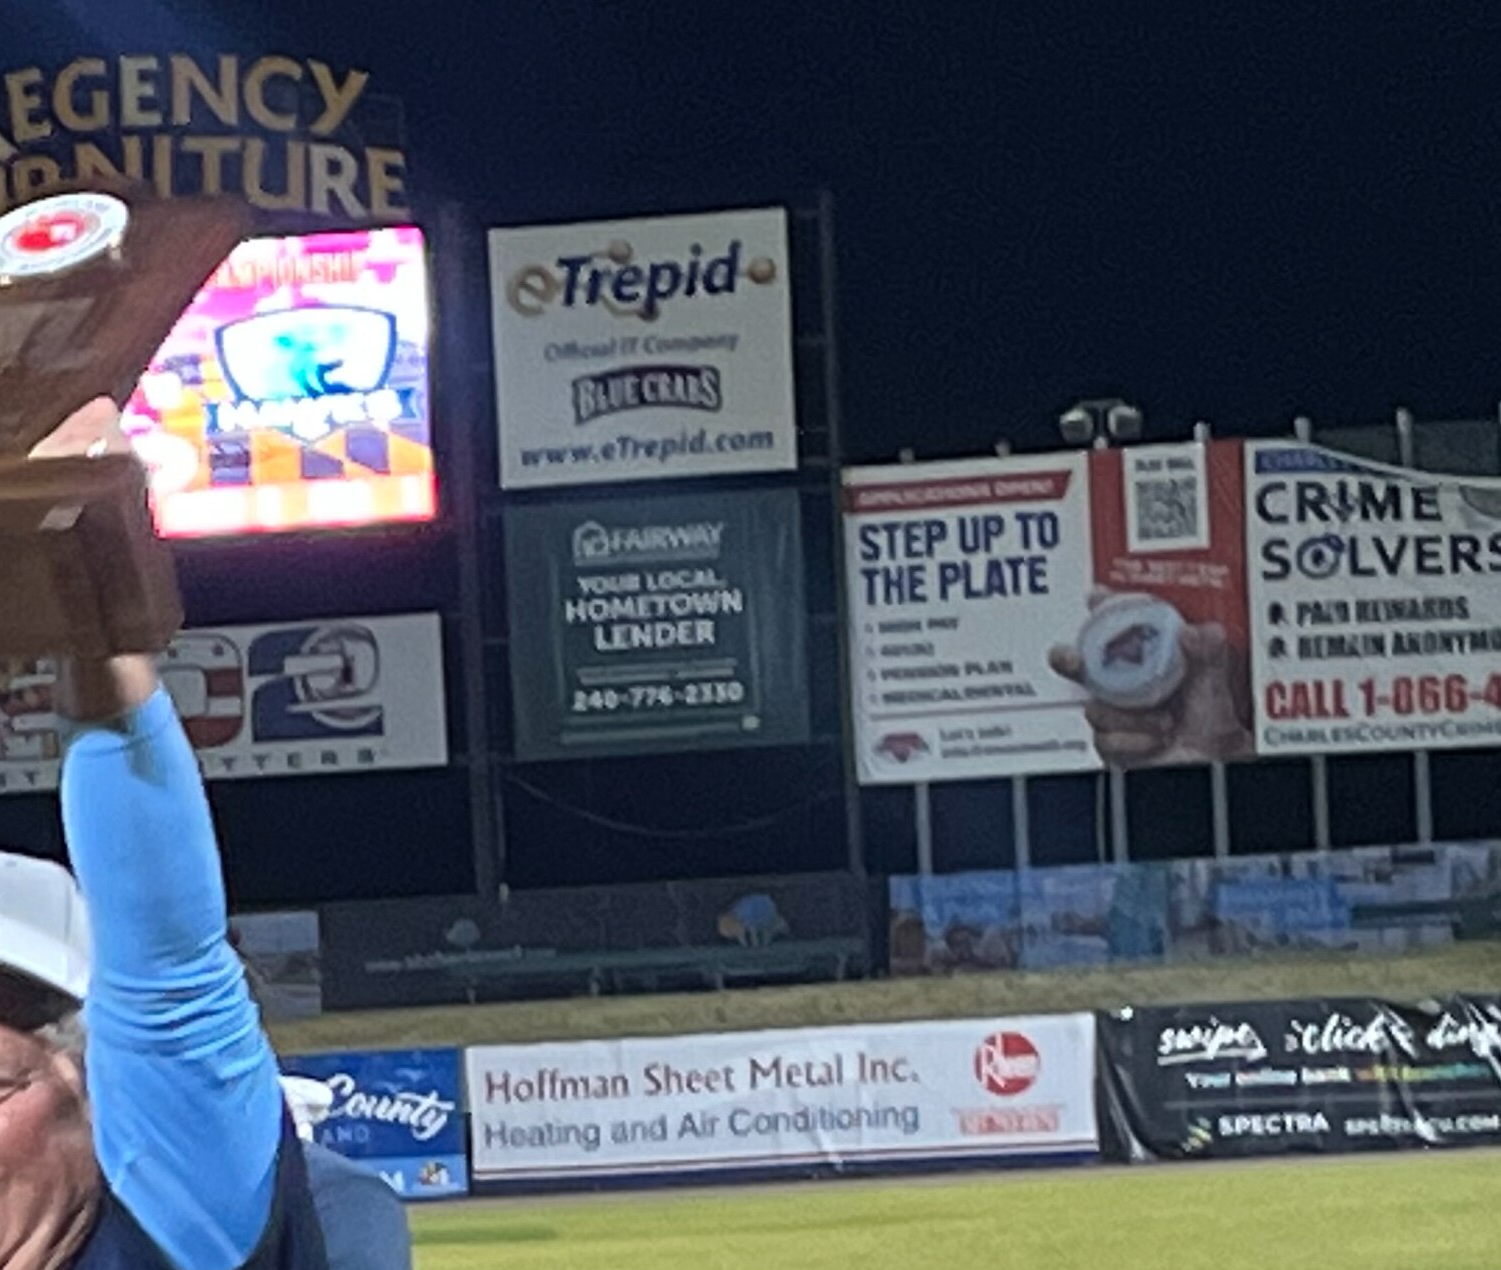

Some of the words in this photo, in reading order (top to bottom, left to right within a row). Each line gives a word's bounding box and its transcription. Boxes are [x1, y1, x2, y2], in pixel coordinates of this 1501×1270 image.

[506, 239, 741, 320] eTrepid
[520, 428, 774, 466] www.eTrepid.com
[1256, 480, 1444, 524] CRIME
[611, 521, 725, 550] FAIRWAY
[859, 520, 948, 560] STEP
[958, 514, 1005, 553] UP
[1015, 511, 1059, 549] TO
[860, 565, 928, 605] THE
[938, 555, 1049, 600] PLATE
[564, 588, 744, 624] HOMETOWN
[1355, 596, 1471, 623] REWARDS
[594, 618, 716, 651] LENDER
[963, 660, 1013, 676] PLAN
[1265, 678, 1351, 720] CALL
[484, 1066, 630, 1104] Hoffman
[643, 1060, 735, 1098] Sheet
[748, 1052, 843, 1091] Metal
[858, 1050, 920, 1085] Inc.
[328, 1072, 456, 1142] County
[483, 1119, 601, 1152] Heating
[609, 1112, 667, 1144] and
[676, 1110, 722, 1139] Air
[726, 1101, 921, 1135] Conditioning
[1218, 1111, 1331, 1137] SPECTRA
